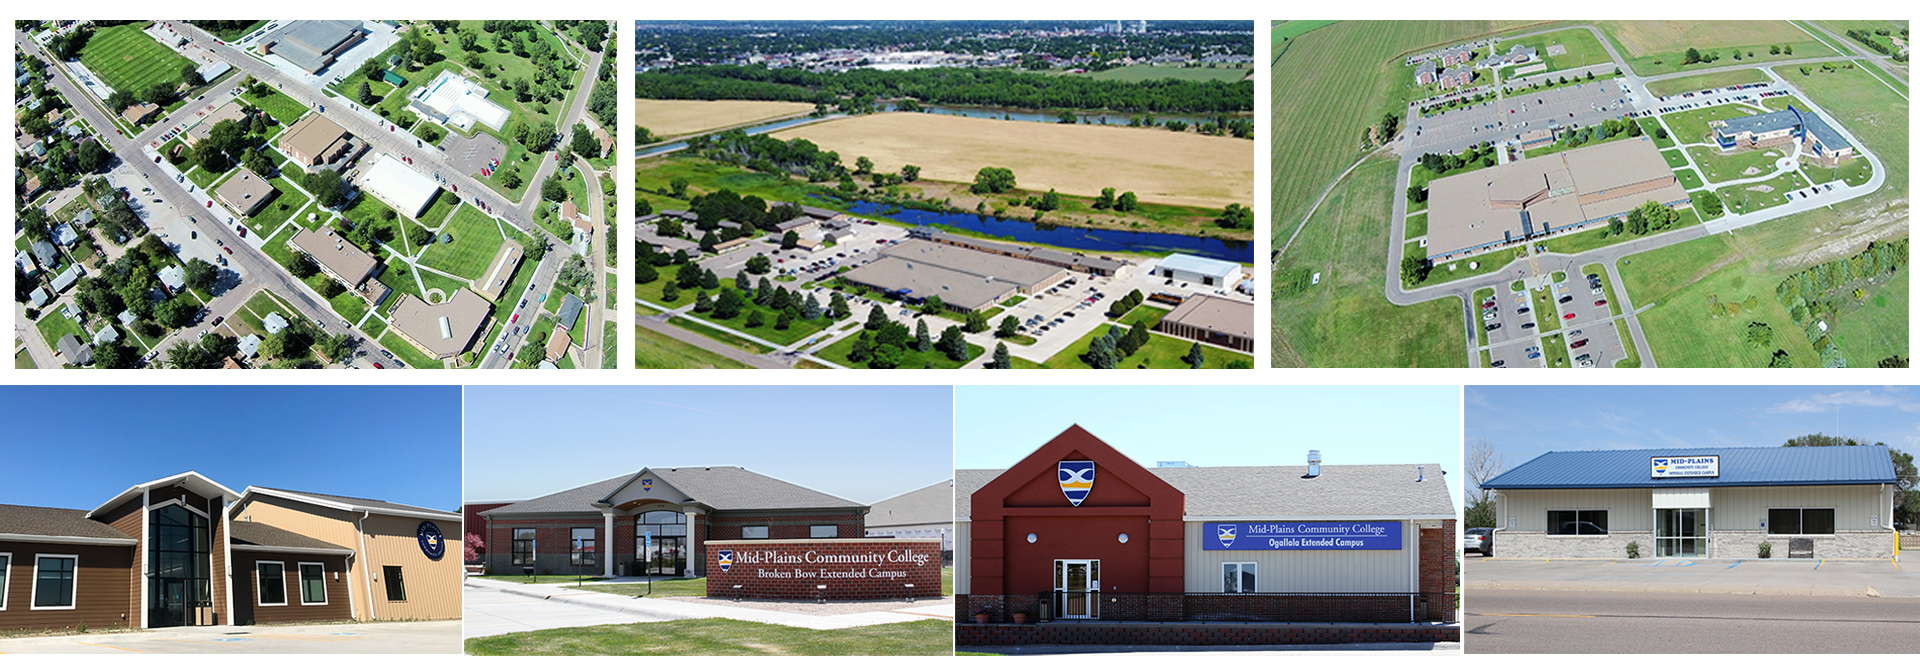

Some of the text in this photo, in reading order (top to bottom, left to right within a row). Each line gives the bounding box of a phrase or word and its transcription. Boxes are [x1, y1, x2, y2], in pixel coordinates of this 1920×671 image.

[1248, 524, 1385, 536] Mid-Plains Community College
[1268, 538, 1364, 548] Ogallala Extended Campus
[735, 549, 930, 566] Mid-Plains Community College
[758, 568, 907, 580] Broken Bow Extended Campus
